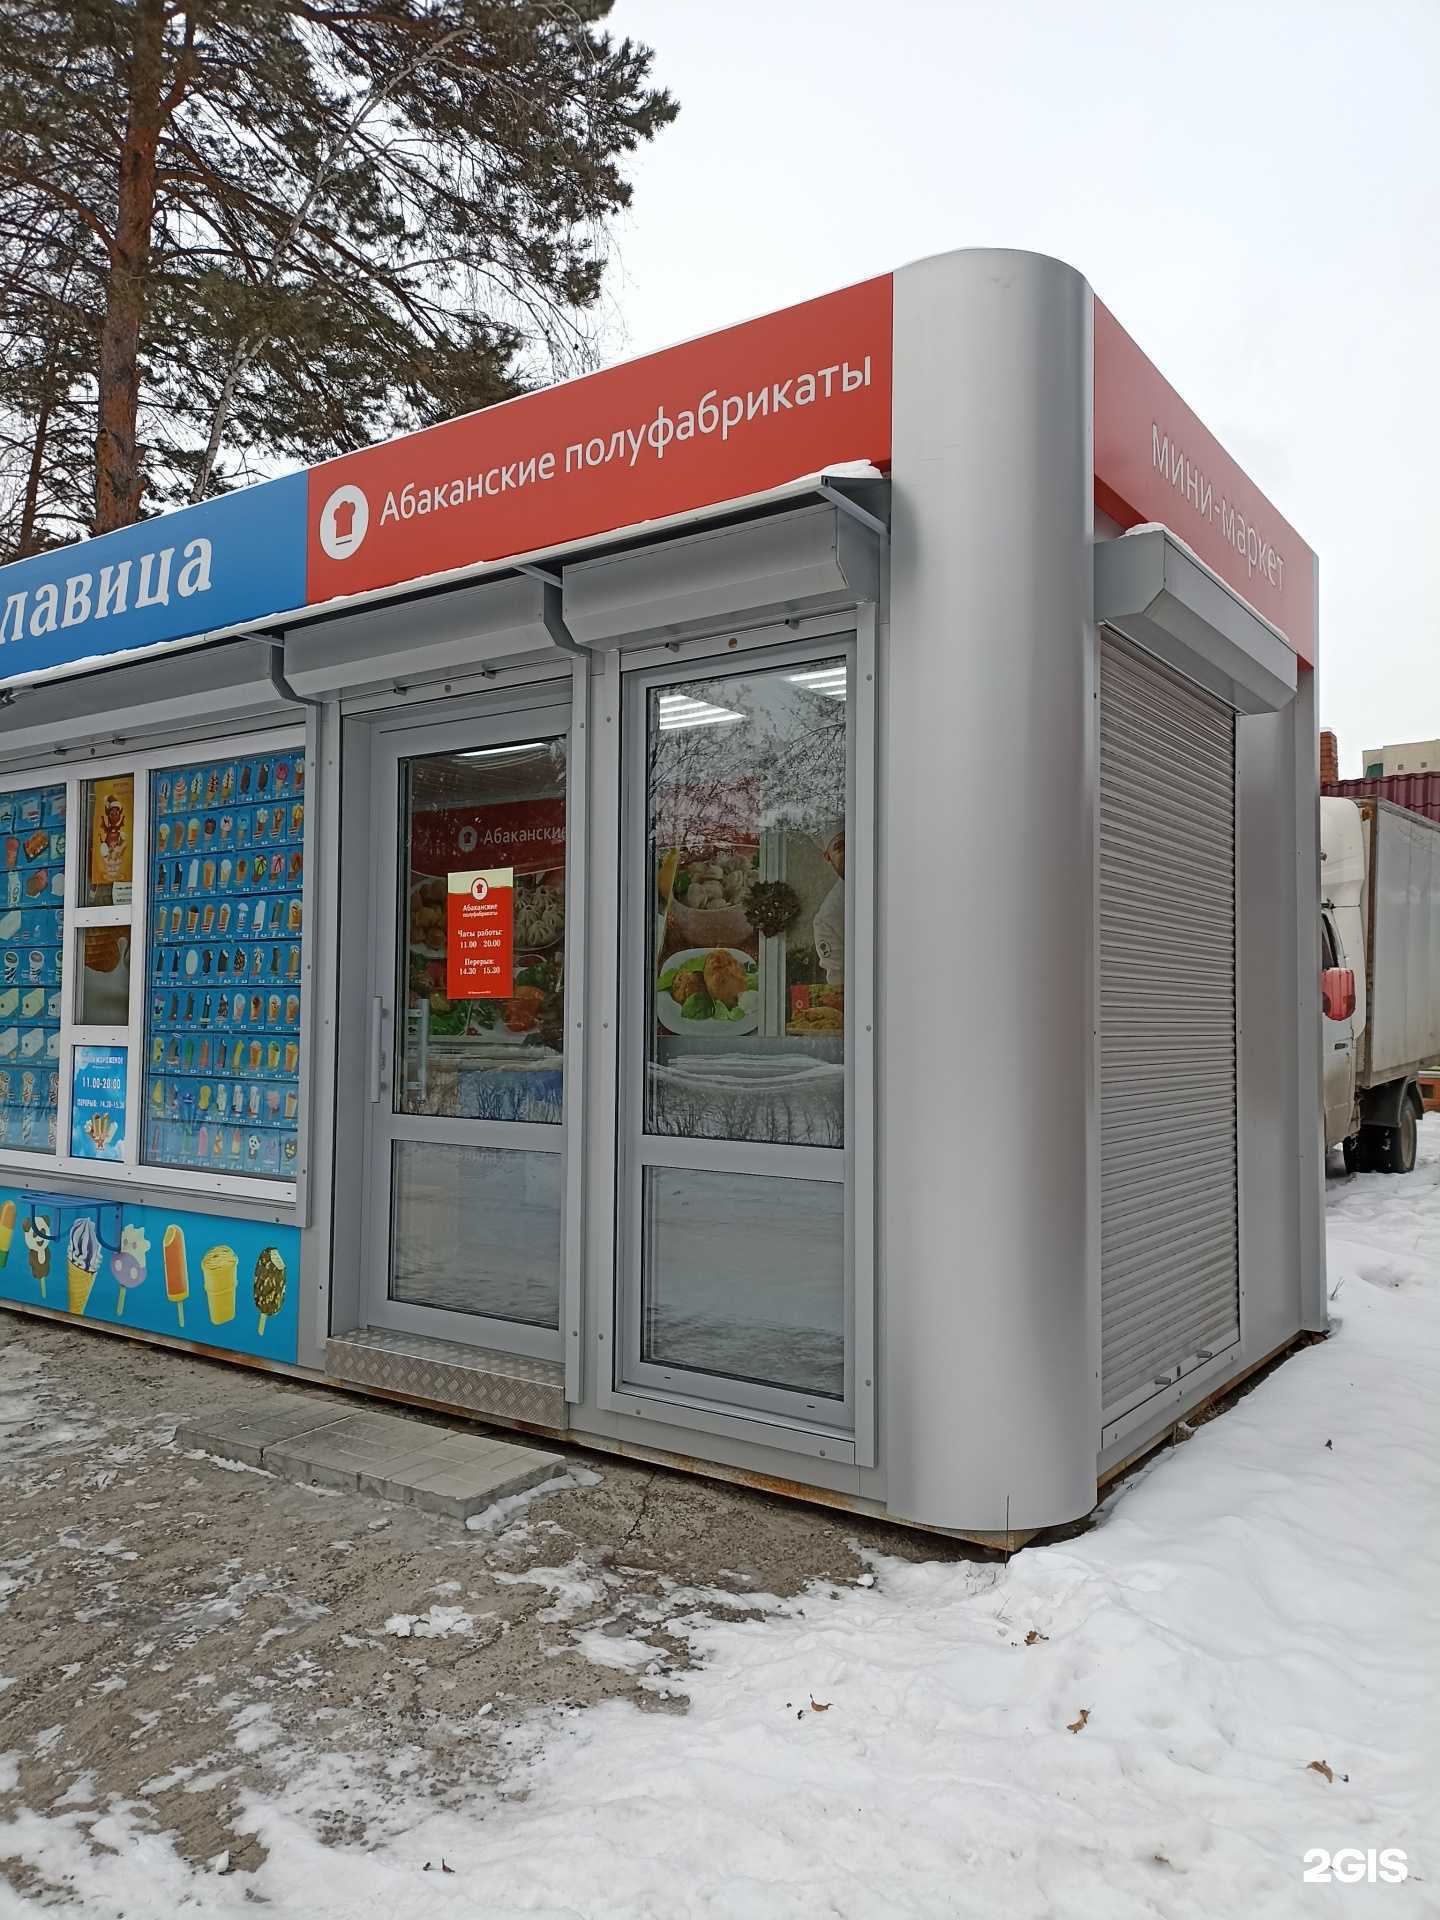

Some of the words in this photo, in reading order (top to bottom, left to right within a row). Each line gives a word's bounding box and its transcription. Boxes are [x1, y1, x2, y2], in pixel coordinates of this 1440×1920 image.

[379, 451, 556, 526] Абаканские
[565, 355, 872, 473] полуфабрикаты
[0, 538, 213, 645] лавица
[457, 929, 475, 937] Часы
[460, 941, 477, 949] 11.00
[483, 939, 501, 948] 20.00
